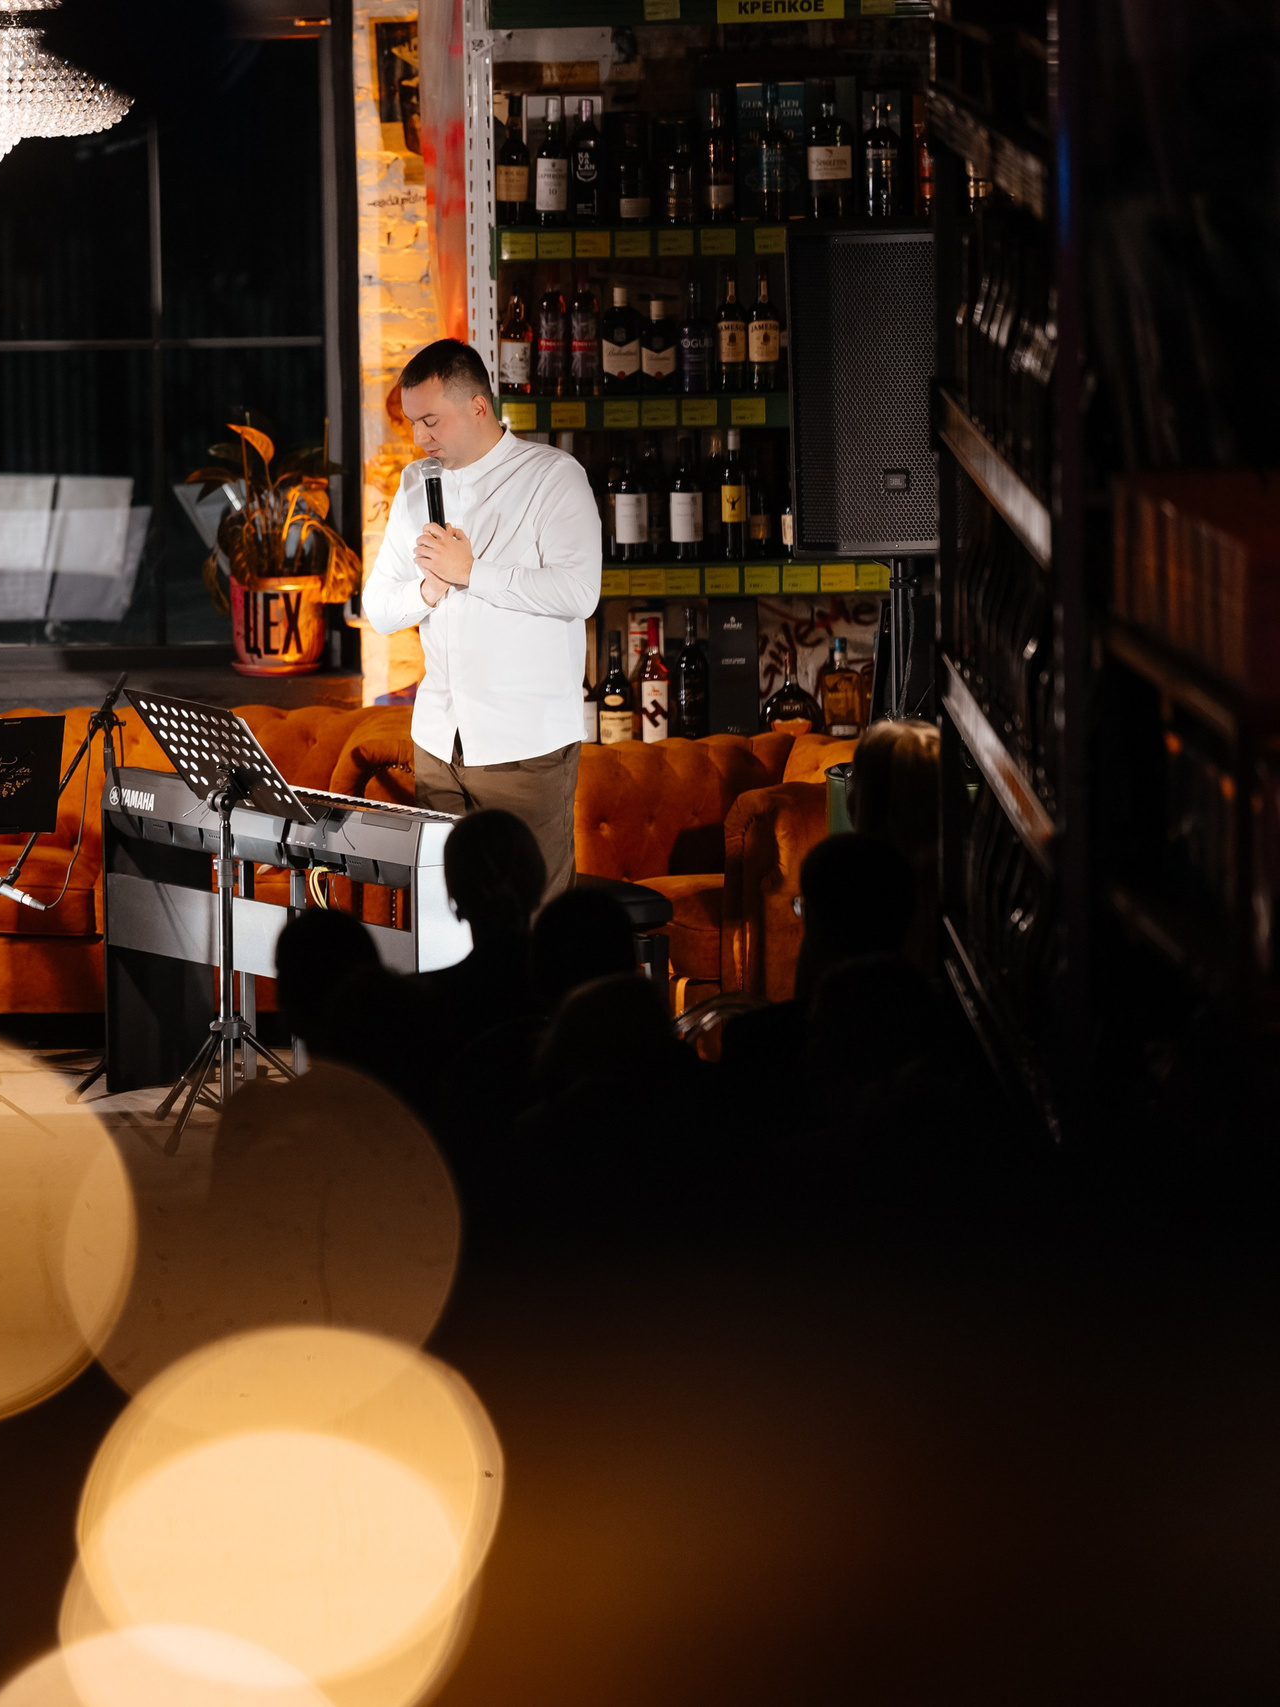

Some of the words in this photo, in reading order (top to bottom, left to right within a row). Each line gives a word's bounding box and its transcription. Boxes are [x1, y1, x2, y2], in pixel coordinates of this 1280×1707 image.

[738, 0, 824, 15] КРЕПКОЕ
[243, 590, 304, 660] ЦЕХ
[121, 788, 155, 812] YAMAHA
